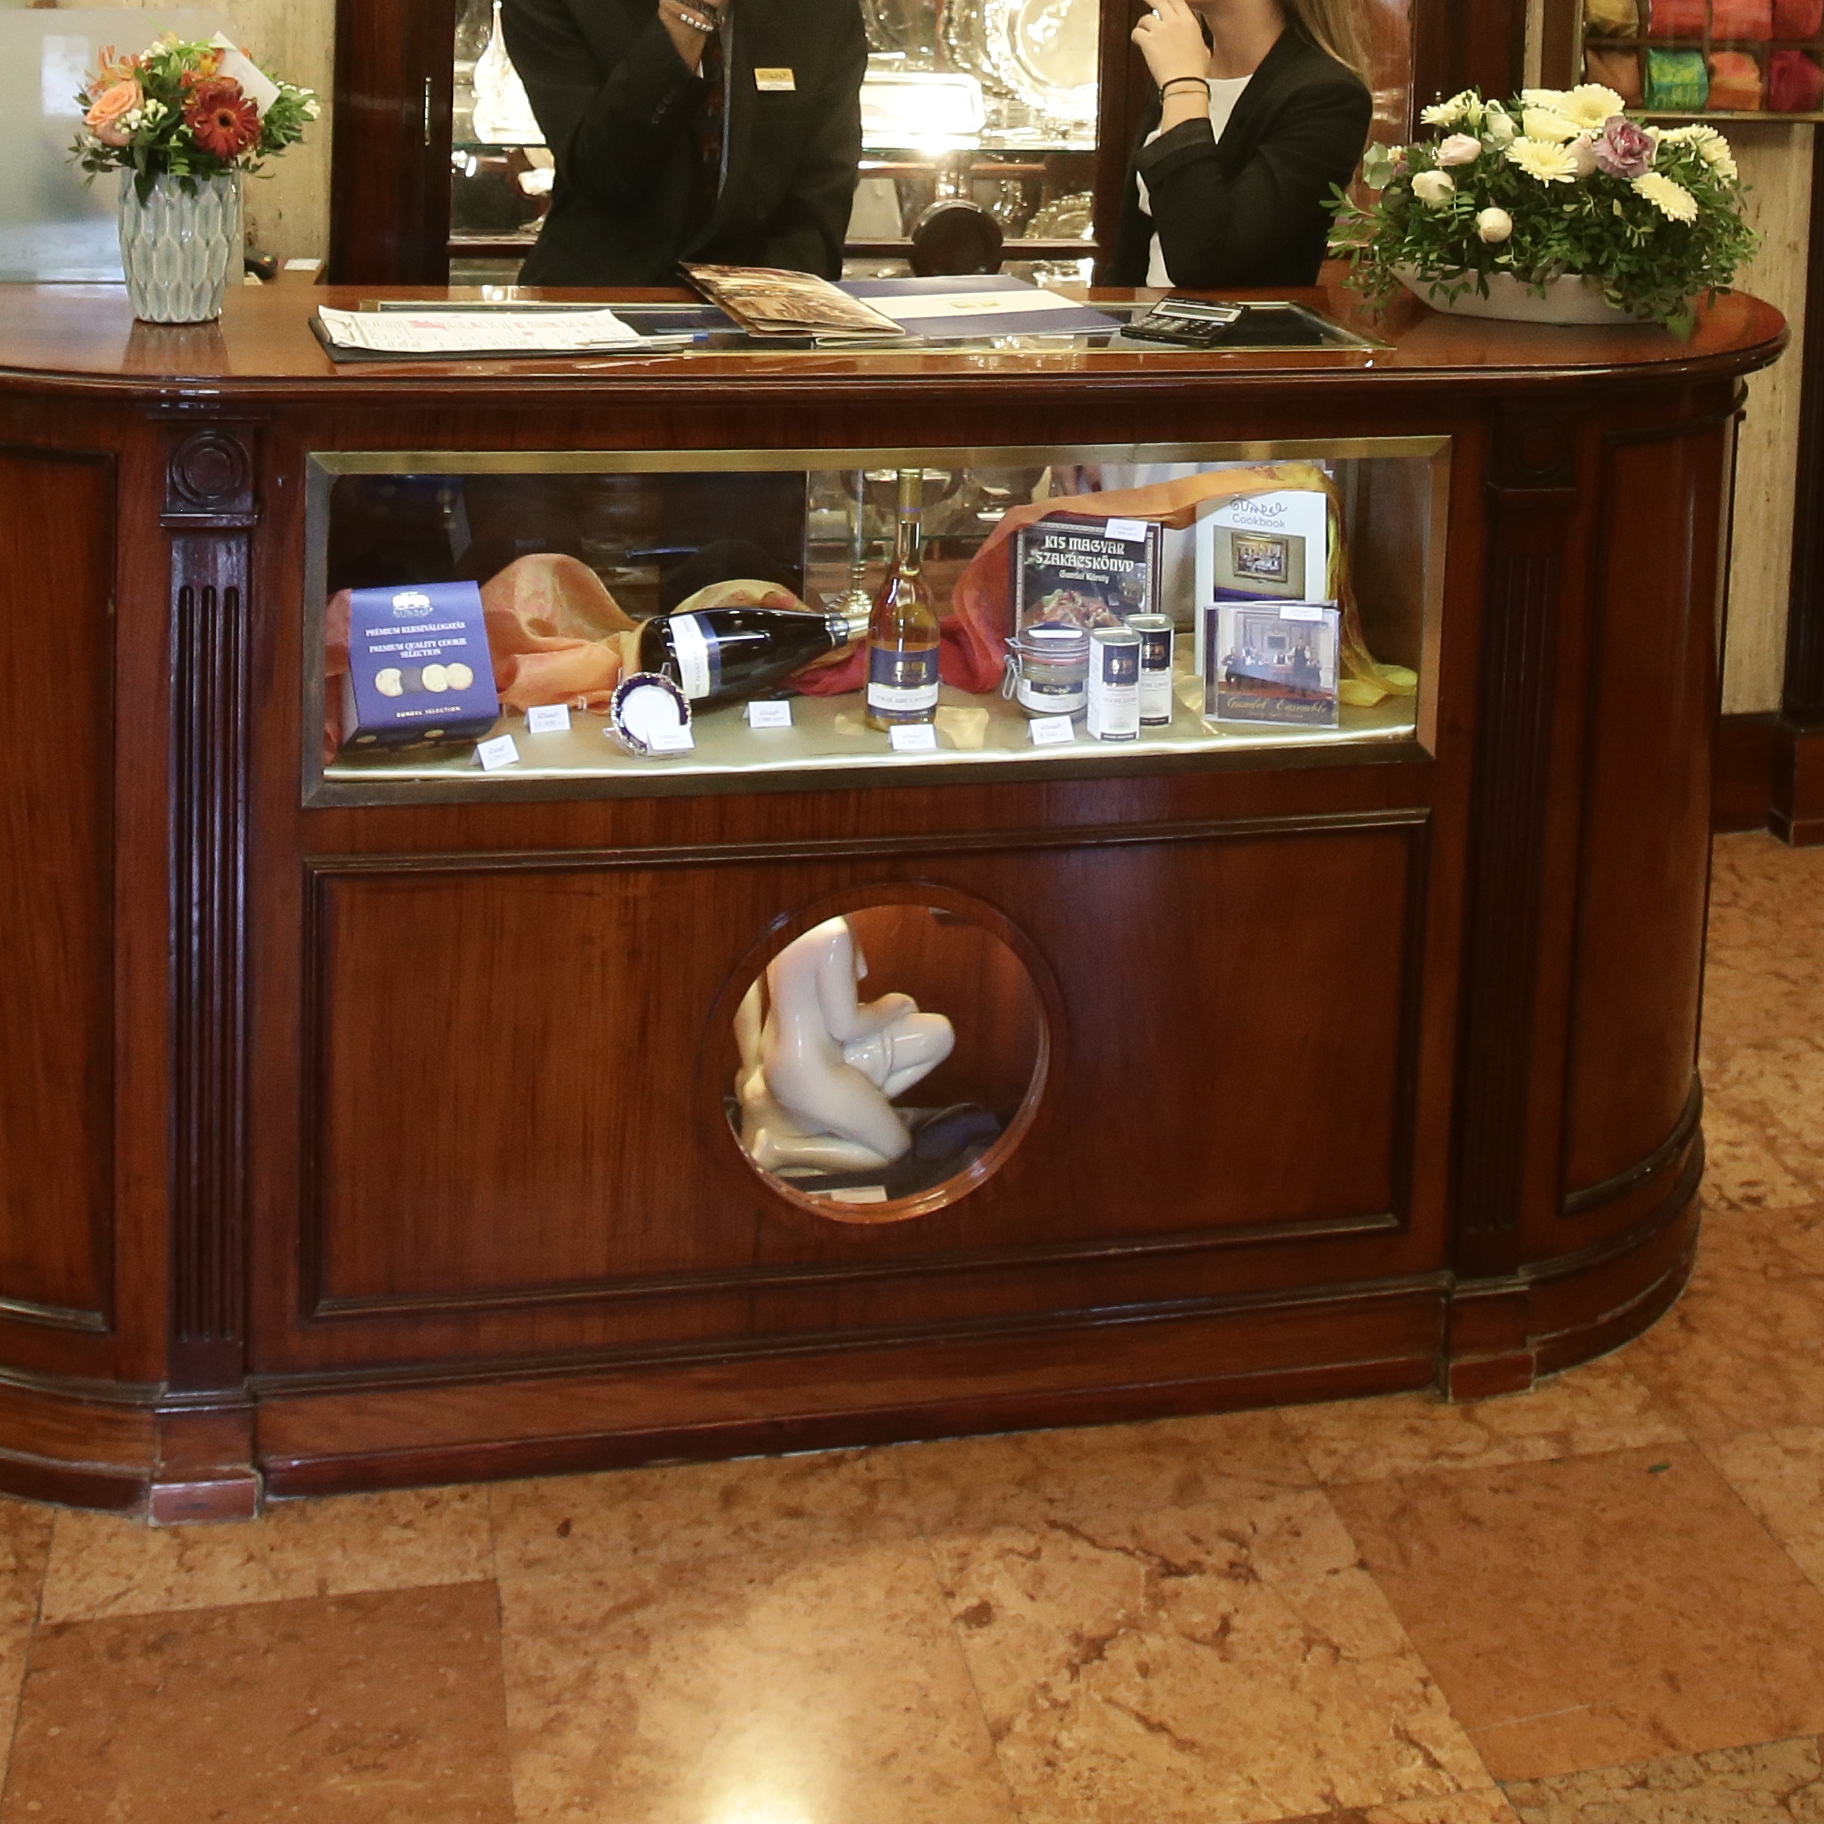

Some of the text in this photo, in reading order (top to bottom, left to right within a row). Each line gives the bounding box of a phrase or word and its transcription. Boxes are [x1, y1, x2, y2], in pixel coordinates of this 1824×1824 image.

[1232, 513, 1286, 529] Cookbook
[1044, 535, 1125, 556] KIS MAGYAR
[1035, 551, 1135, 574] SZAKÁCSKÖNYV
[369, 642, 404, 653] PREMIUM
[405, 640, 437, 651] QUALITY
